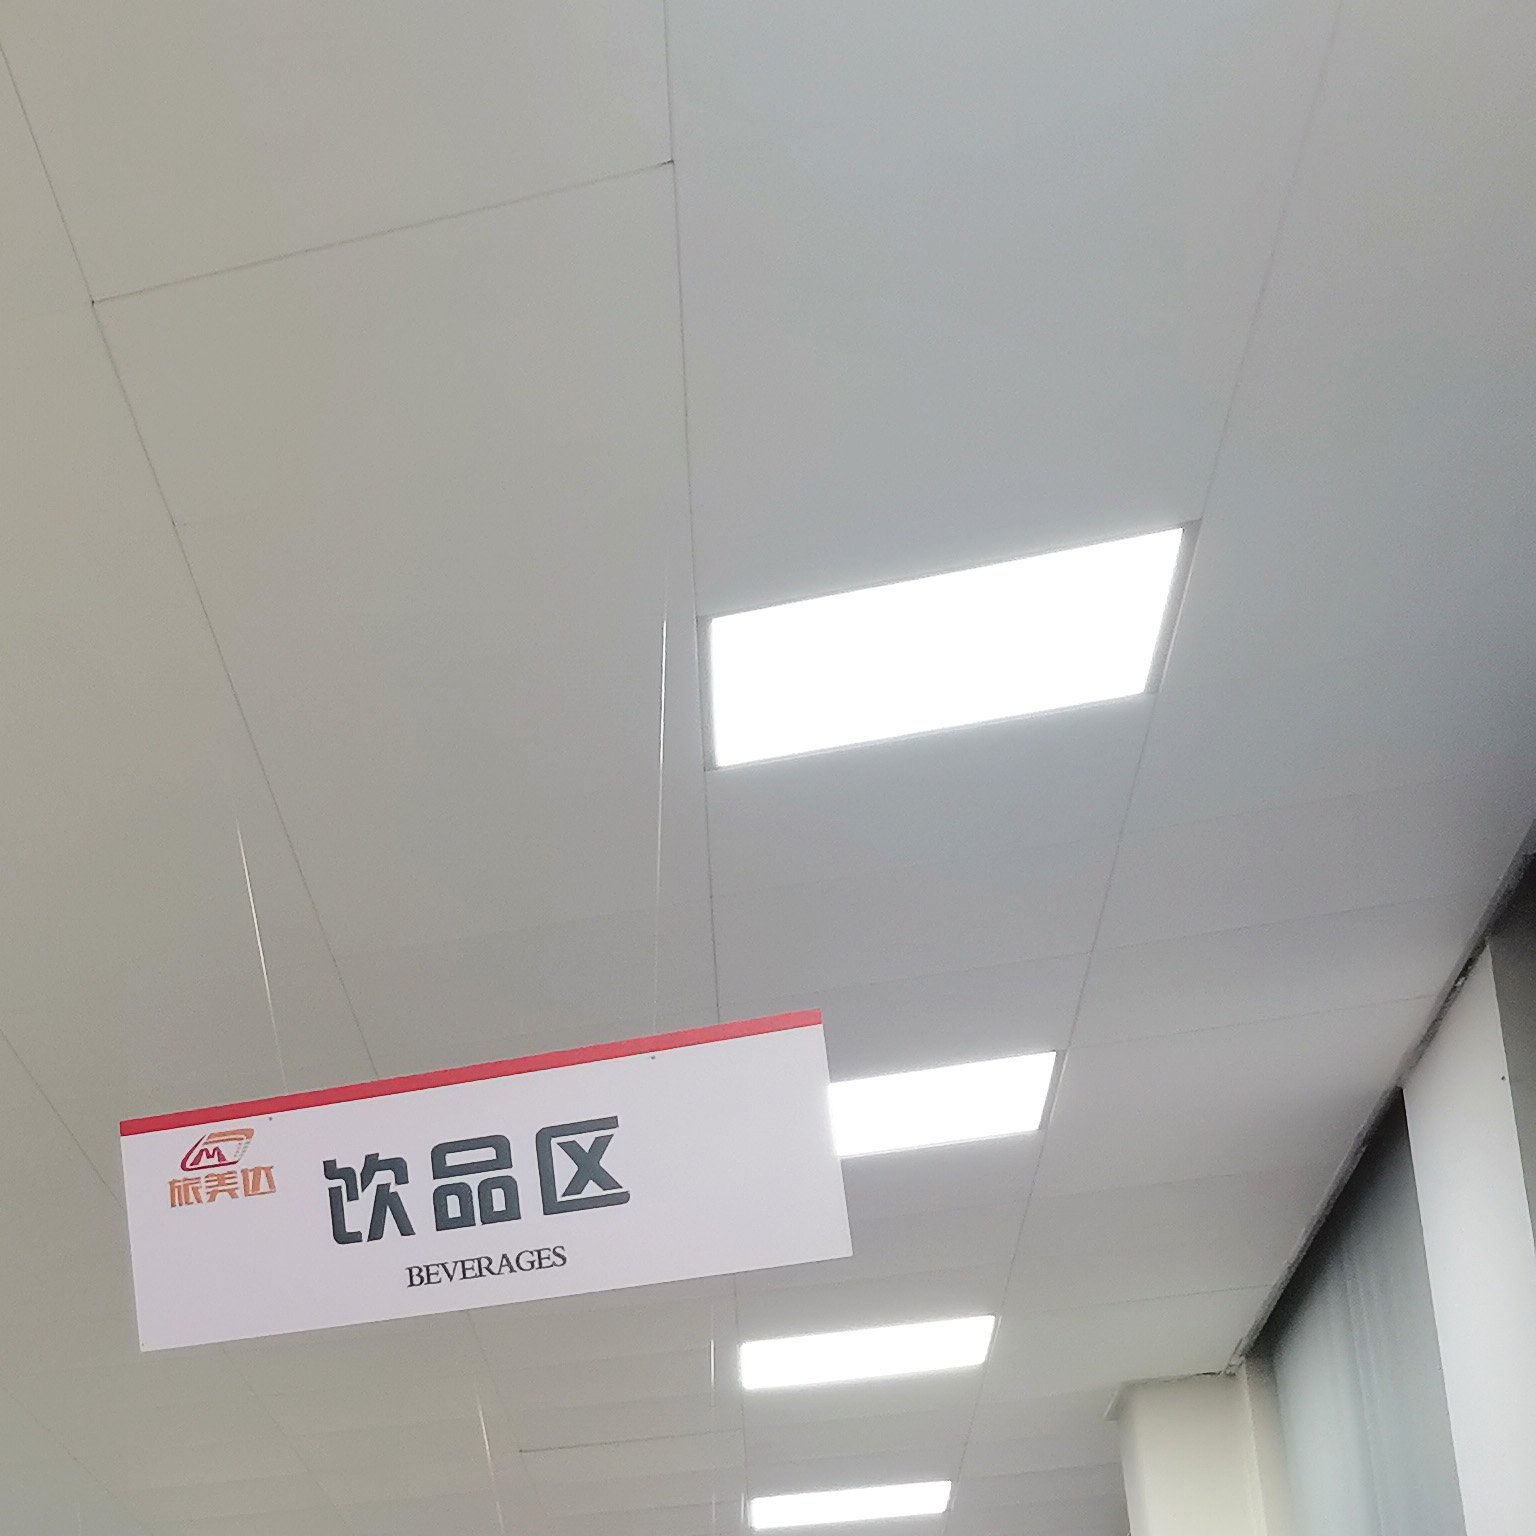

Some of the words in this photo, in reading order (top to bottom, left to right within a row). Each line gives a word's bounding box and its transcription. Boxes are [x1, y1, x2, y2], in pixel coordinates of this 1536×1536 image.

[168, 1164, 276, 1209] 旅美达
[322, 1114, 631, 1246] 饮品区
[405, 1245, 567, 1289] BEVERAGES
